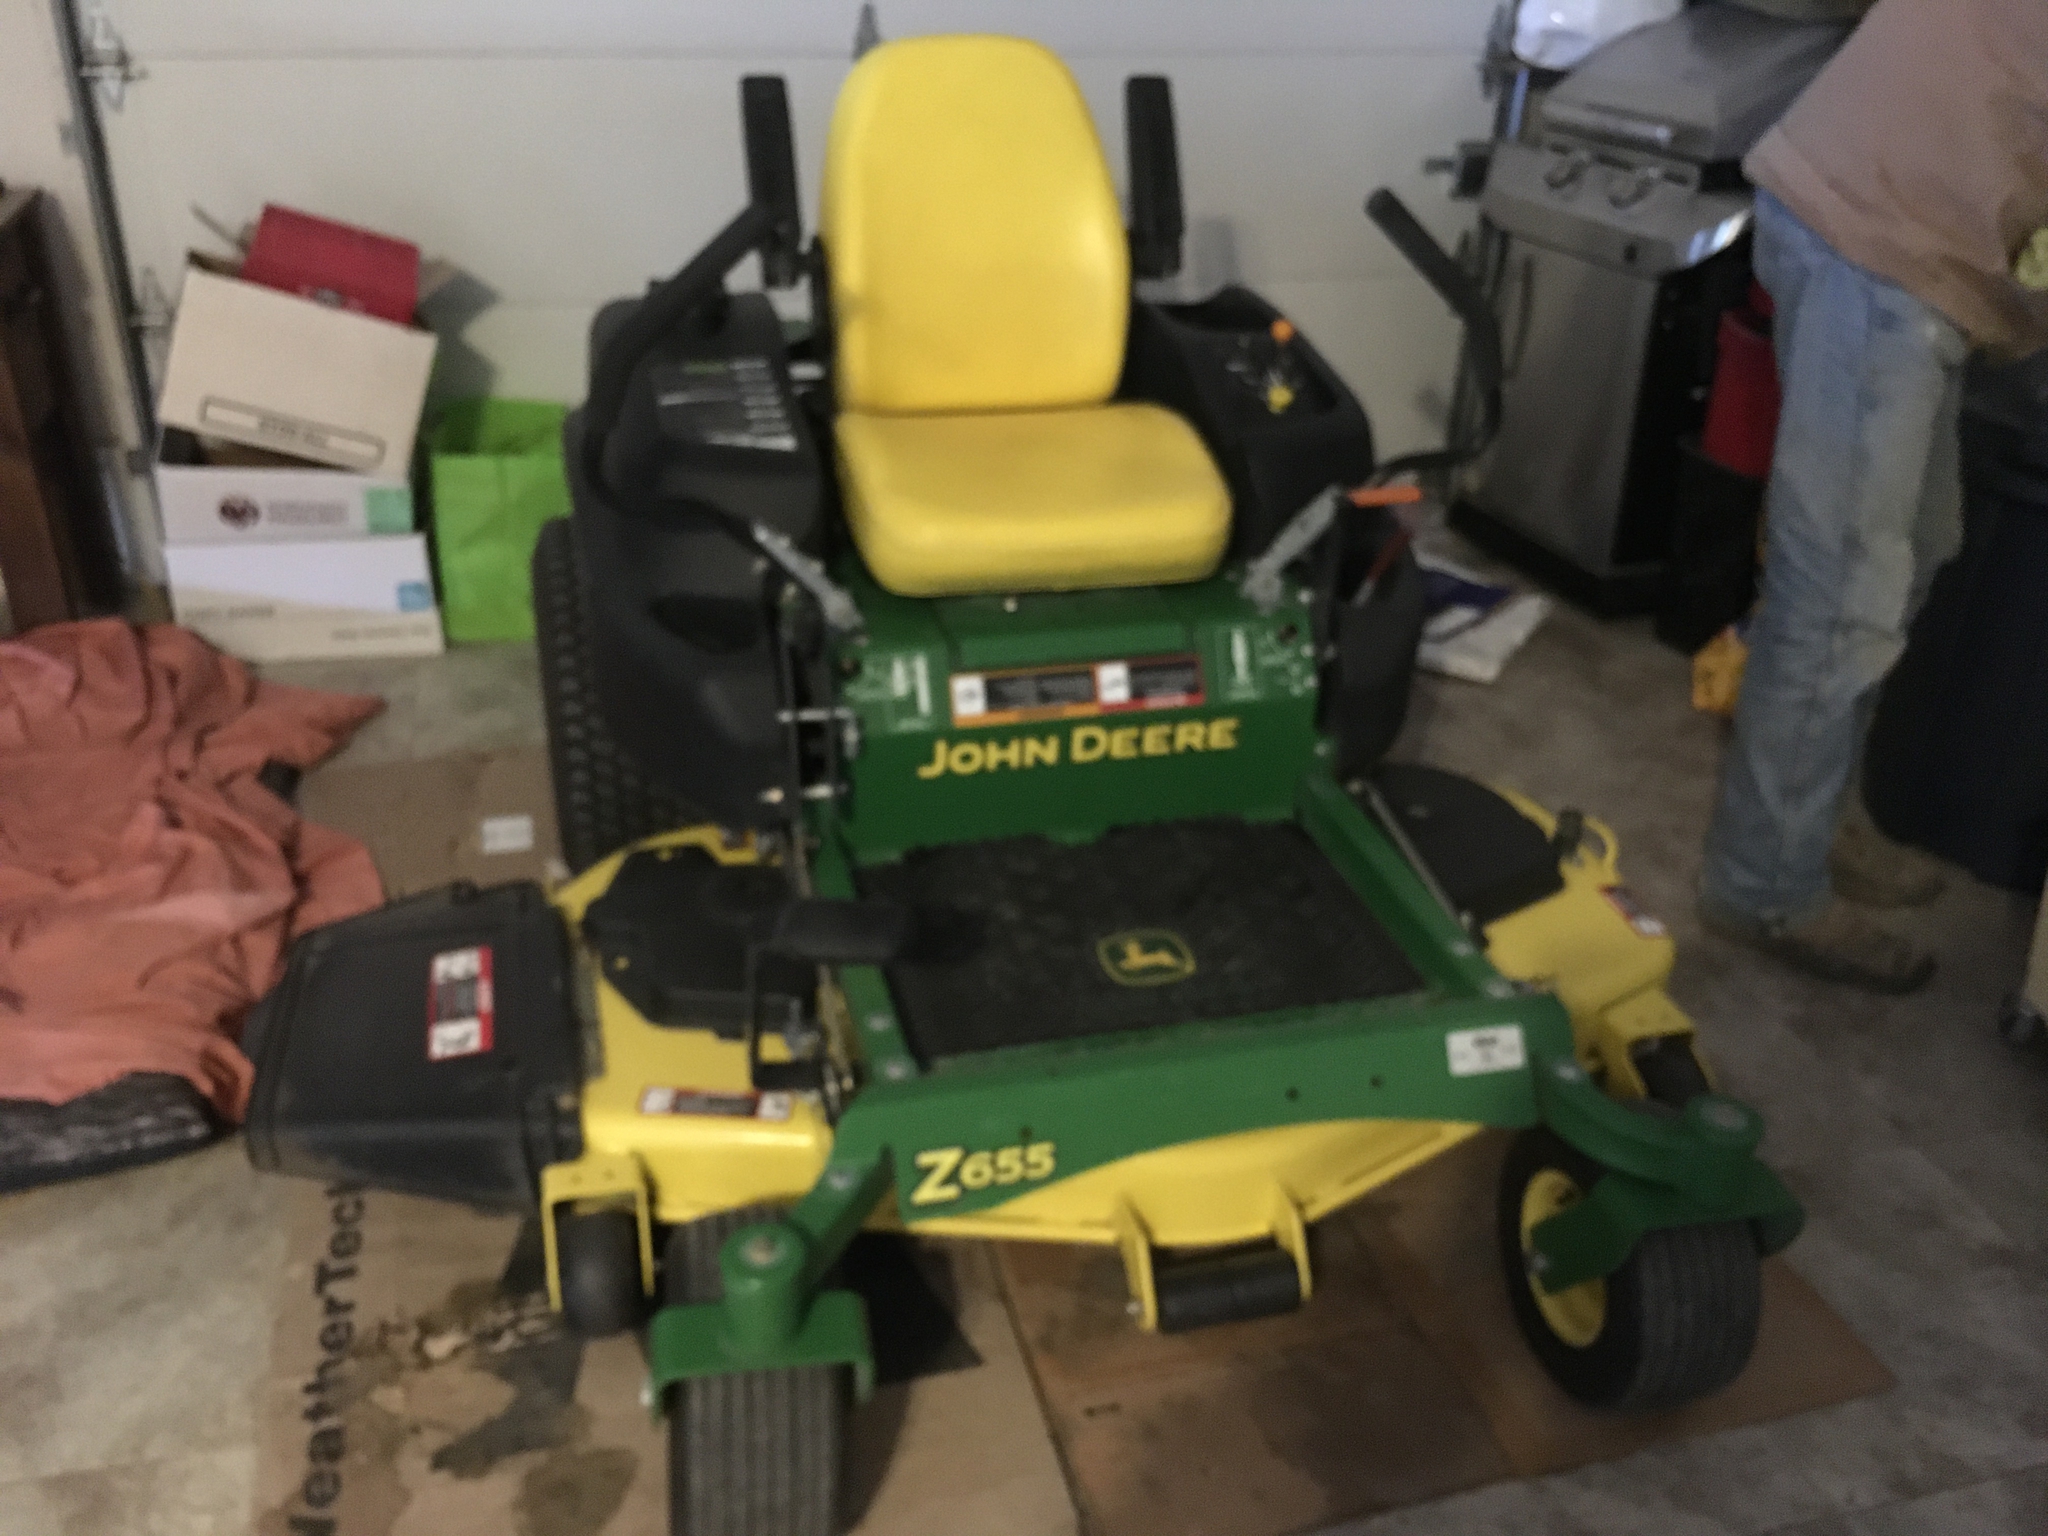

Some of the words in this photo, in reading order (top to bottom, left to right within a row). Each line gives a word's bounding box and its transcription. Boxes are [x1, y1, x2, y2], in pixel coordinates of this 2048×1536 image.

[917, 735, 1060, 779] JOHN
[1070, 718, 1239, 763] DEERE
[911, 1141, 1056, 1206] Z655
